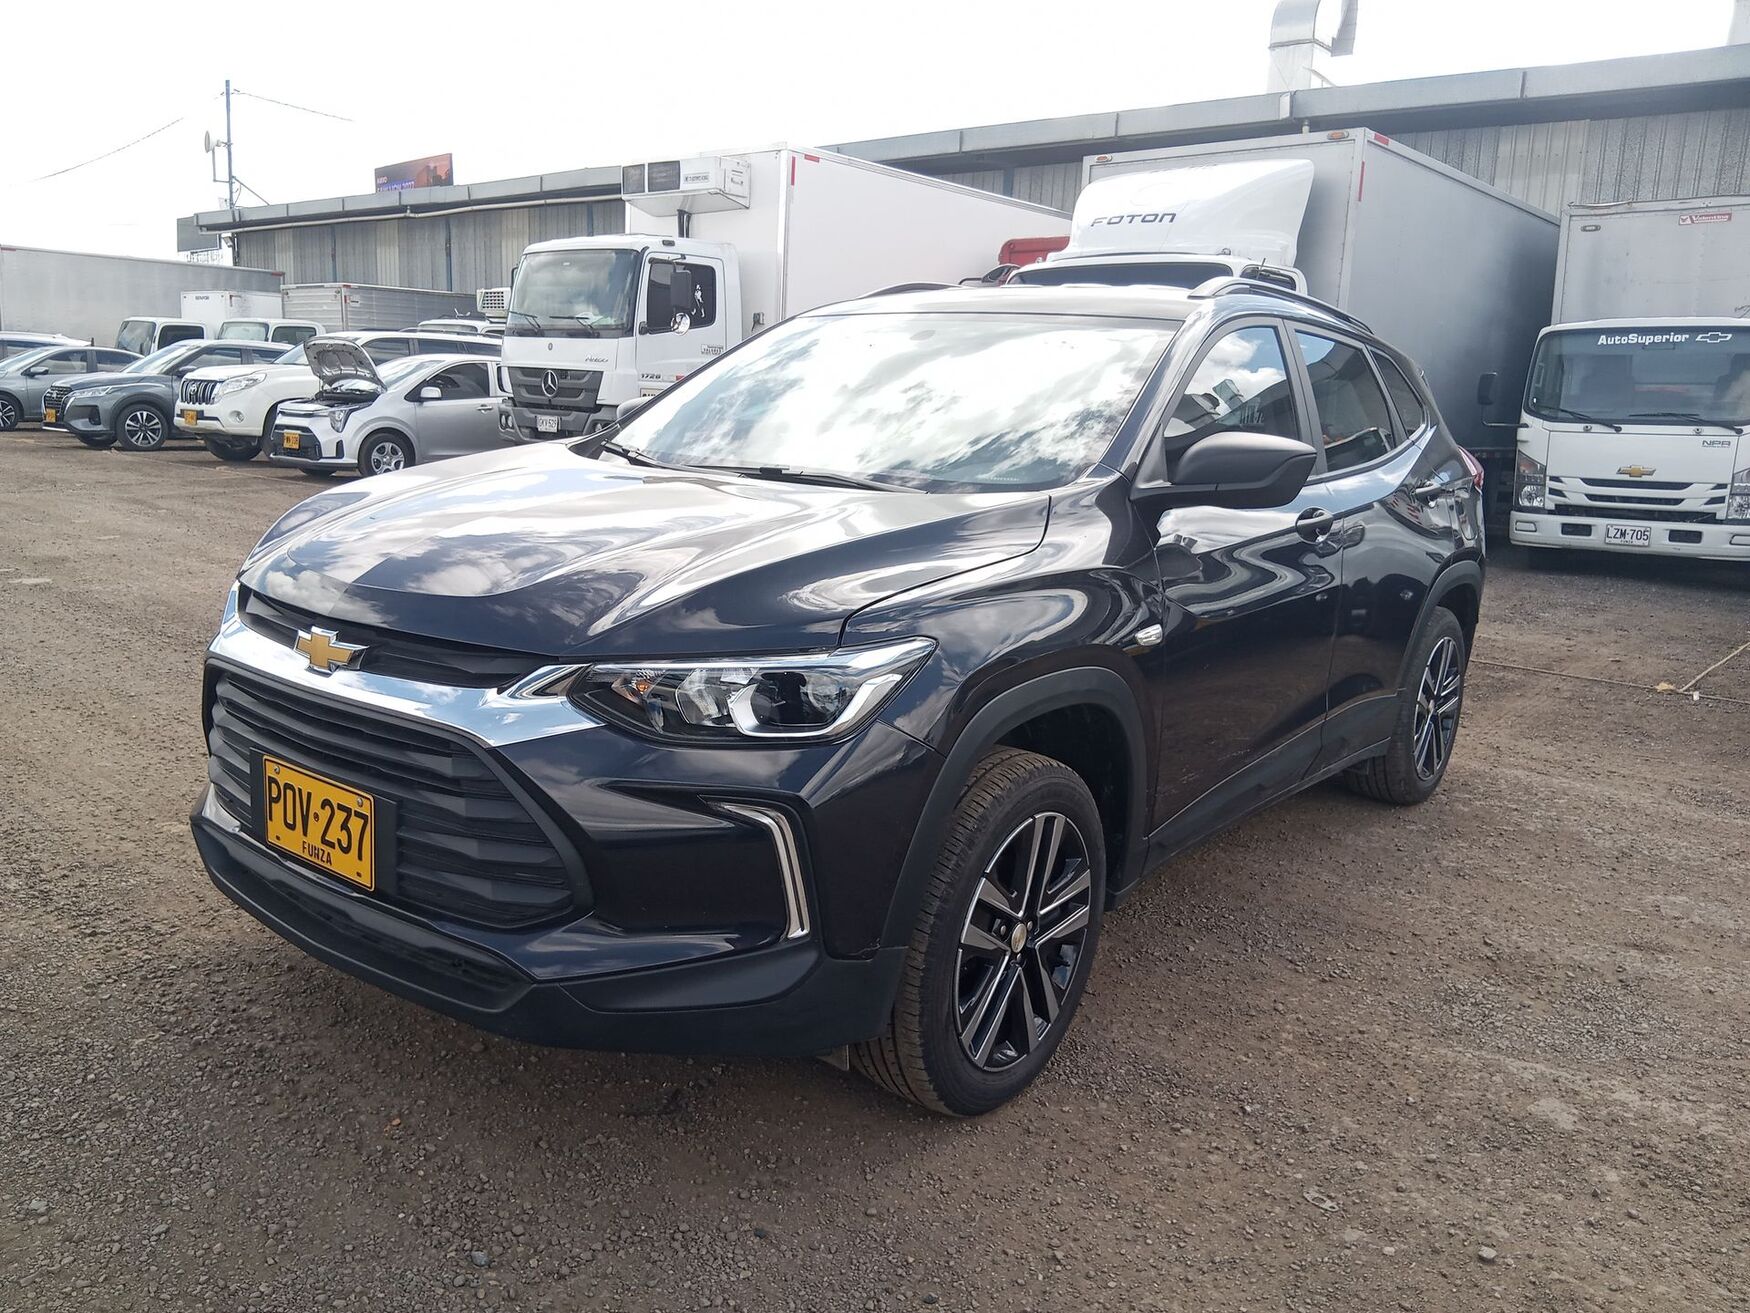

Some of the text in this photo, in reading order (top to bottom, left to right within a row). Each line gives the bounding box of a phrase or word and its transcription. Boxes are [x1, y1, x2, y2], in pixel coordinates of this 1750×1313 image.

[1090, 213, 1176, 227] FOTON
[1597, 332, 1689, 345] AutoSuperior
[302, 840, 333, 866] FUNZA
